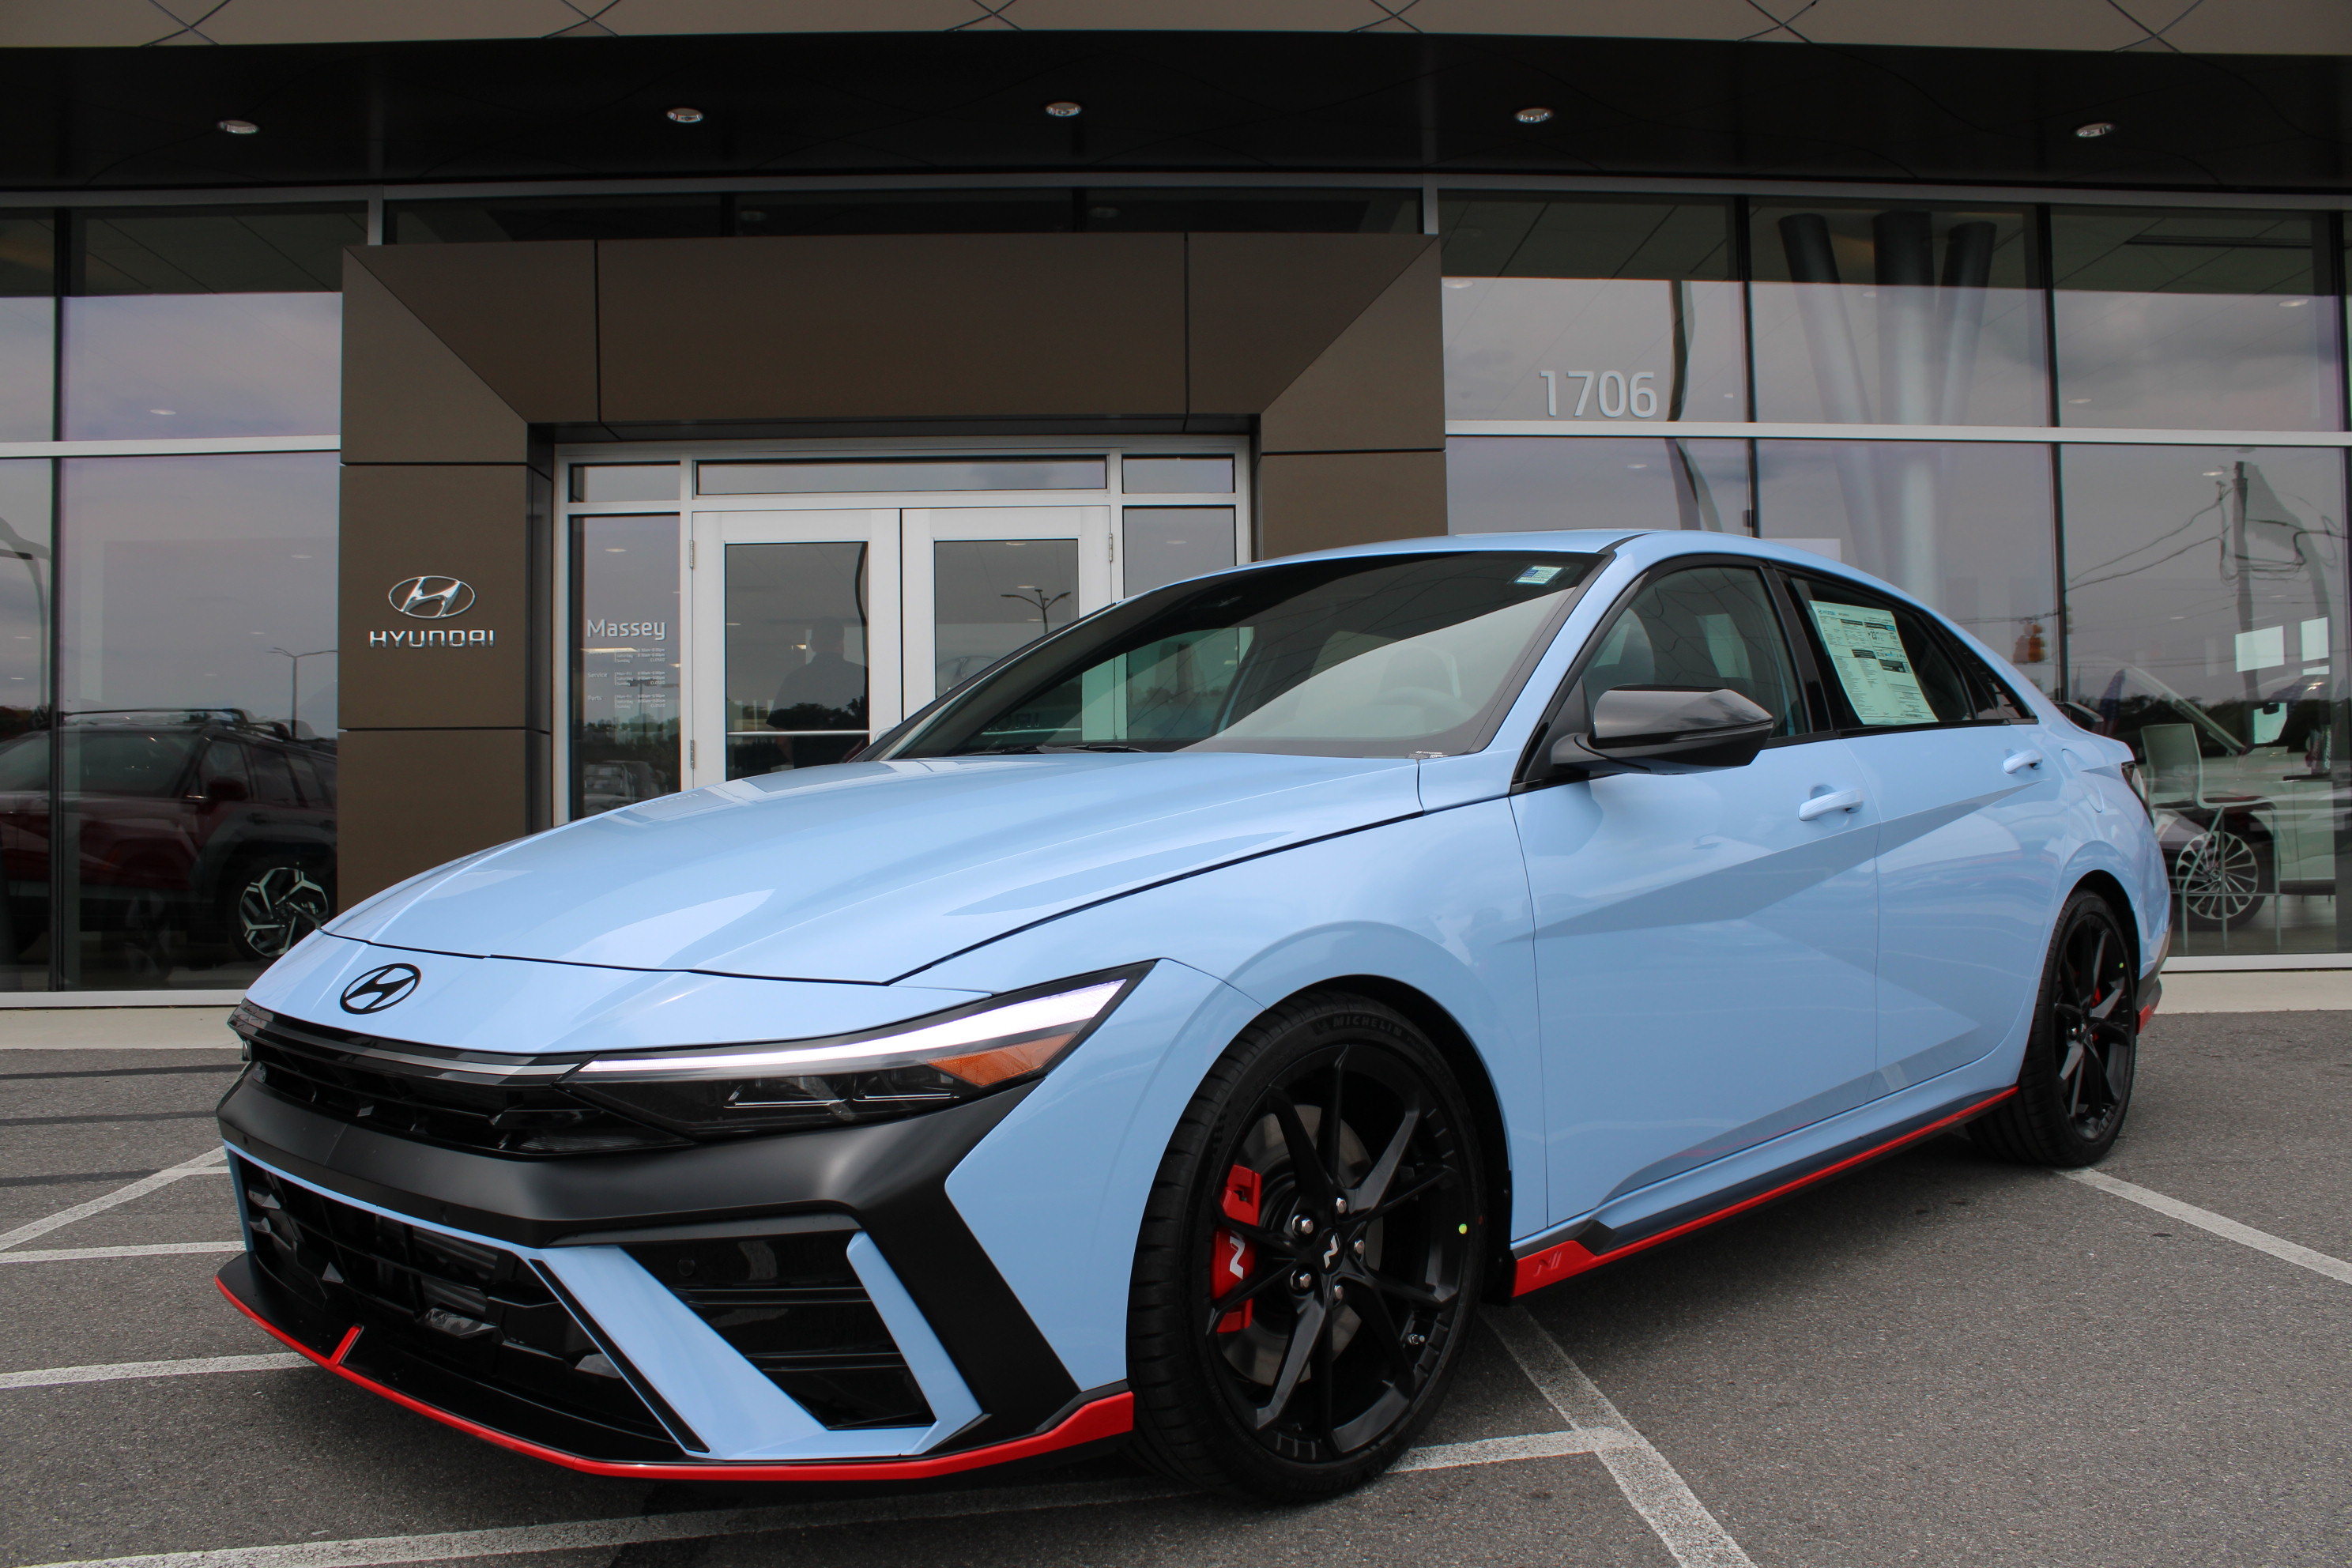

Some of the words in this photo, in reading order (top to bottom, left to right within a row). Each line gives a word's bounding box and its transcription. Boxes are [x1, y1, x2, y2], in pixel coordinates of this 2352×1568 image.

[1540, 370, 1657, 418] 1706
[369, 630, 496, 648] HYUNDAI
[587, 619, 666, 641] Massey
[1332, 1015, 1403, 1037] MICHELIN
